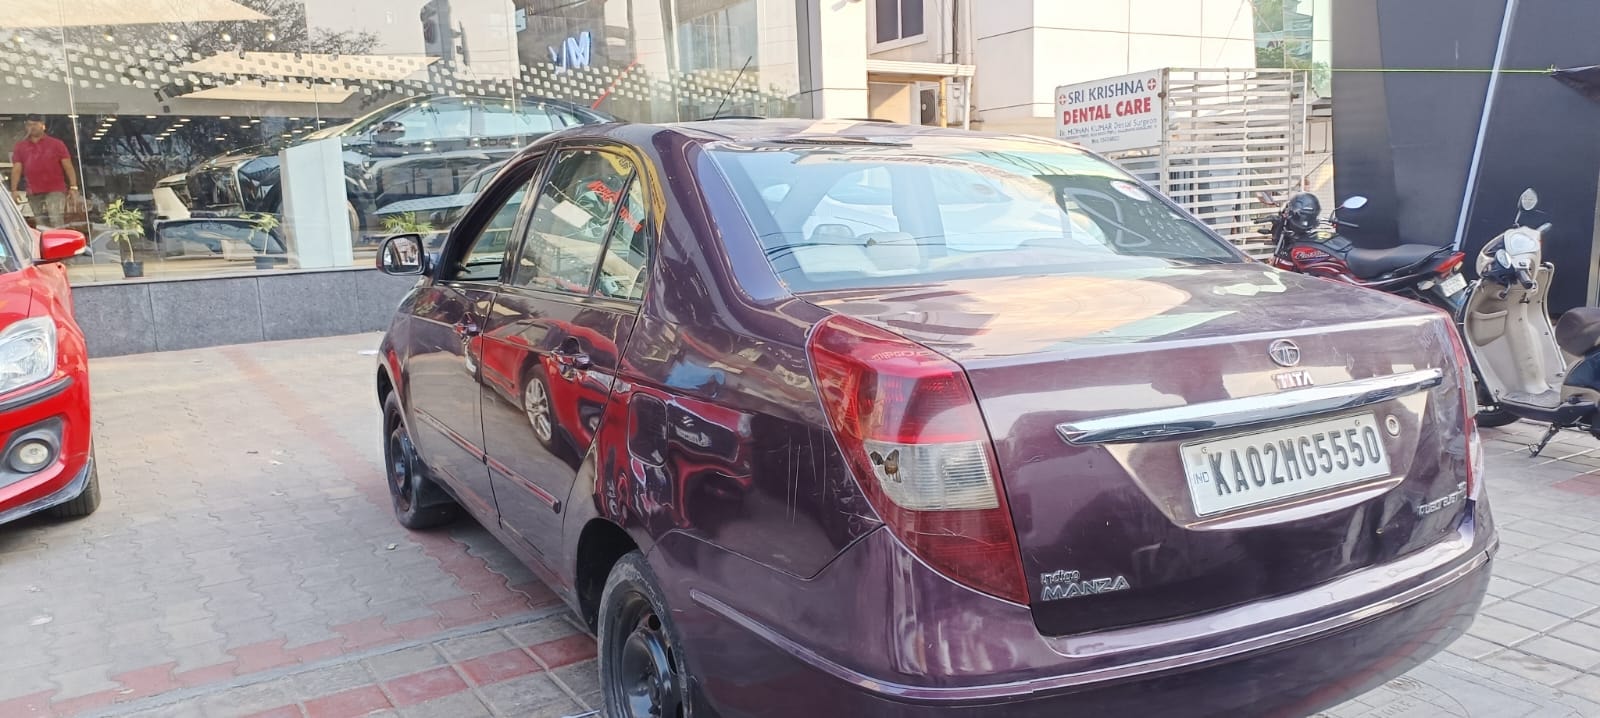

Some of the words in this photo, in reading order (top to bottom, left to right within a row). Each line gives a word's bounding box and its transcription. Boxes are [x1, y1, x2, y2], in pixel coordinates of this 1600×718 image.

[1068, 88, 1085, 104] SRI
[1088, 80, 1144, 102] KRISHNA
[1063, 104, 1111, 126] DENTAL
[1115, 96, 1151, 117] CARE
[1274, 370, 1314, 389] TATA
[1208, 425, 1381, 496] KA02MG5550
[1192, 471, 1210, 485] IND
[1042, 575, 1131, 601] MANZA
